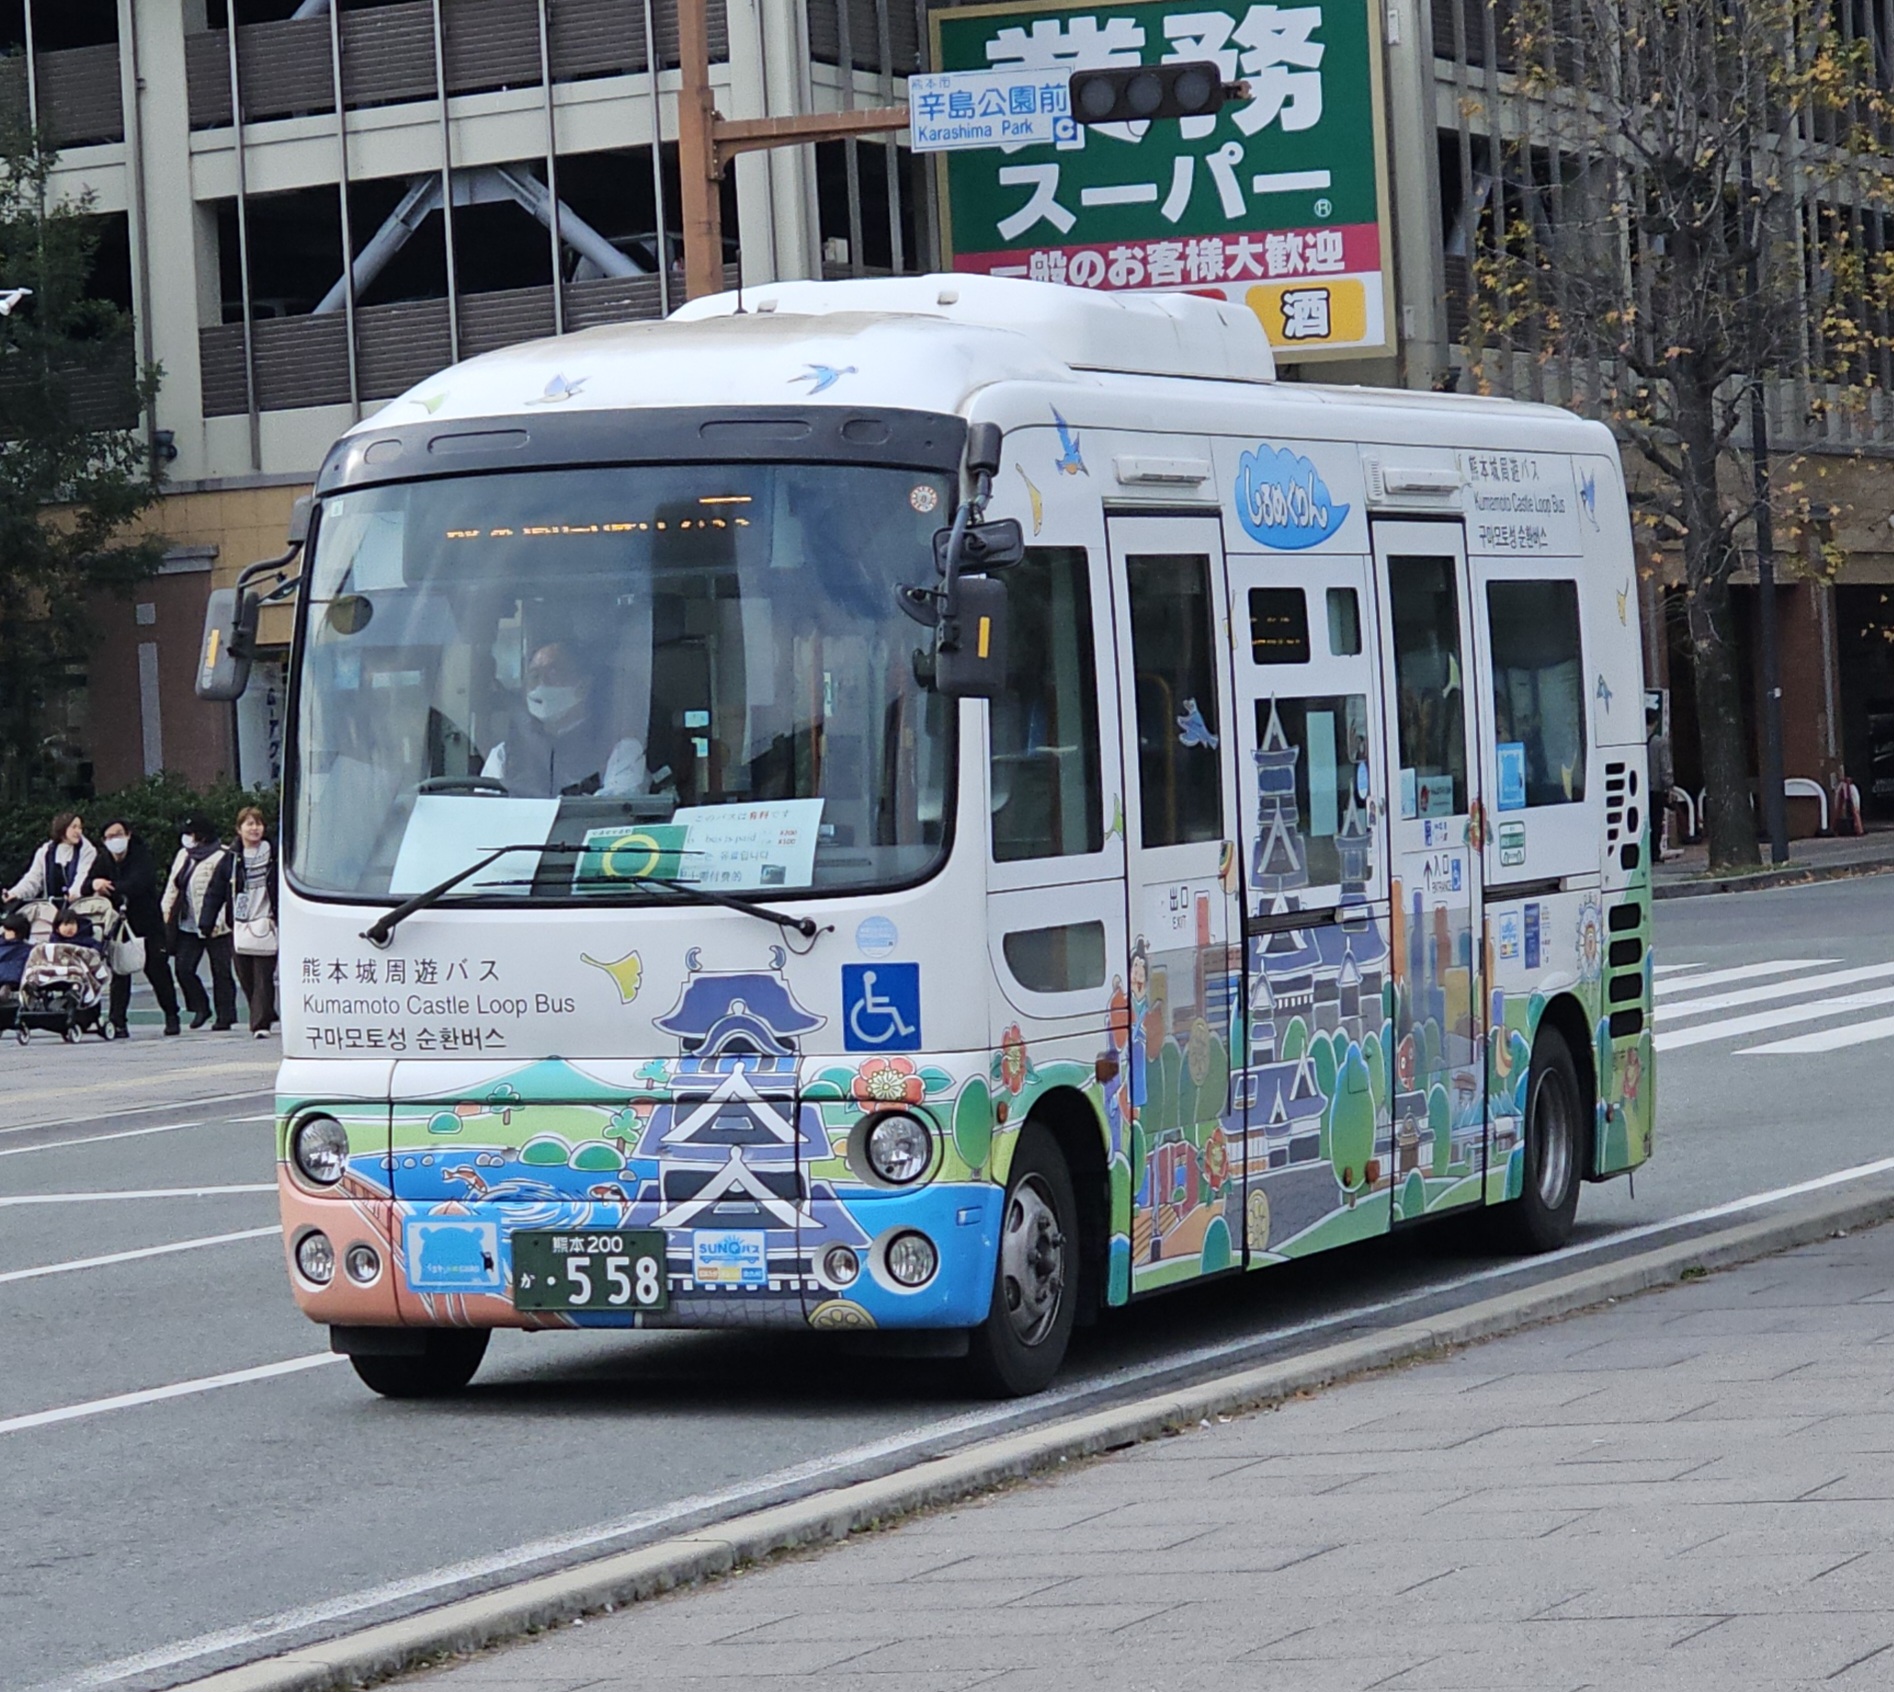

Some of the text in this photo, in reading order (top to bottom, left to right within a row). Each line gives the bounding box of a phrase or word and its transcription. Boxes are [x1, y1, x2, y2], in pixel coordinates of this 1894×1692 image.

[918, 83, 1068, 122] 辛島公園前
[918, 119, 1034, 142] Karashima Park
[996, 141, 1332, 242] スーパー
[989, 229, 1346, 288] 一般のお客様大歓迎
[1281, 287, 1332, 339] 酒
[302, 957, 500, 986] 熊本城周遊バス
[303, 992, 576, 1019] Kumamoto Castle Loop Bus
[305, 1026, 507, 1052] 구마모토성 순환버스
